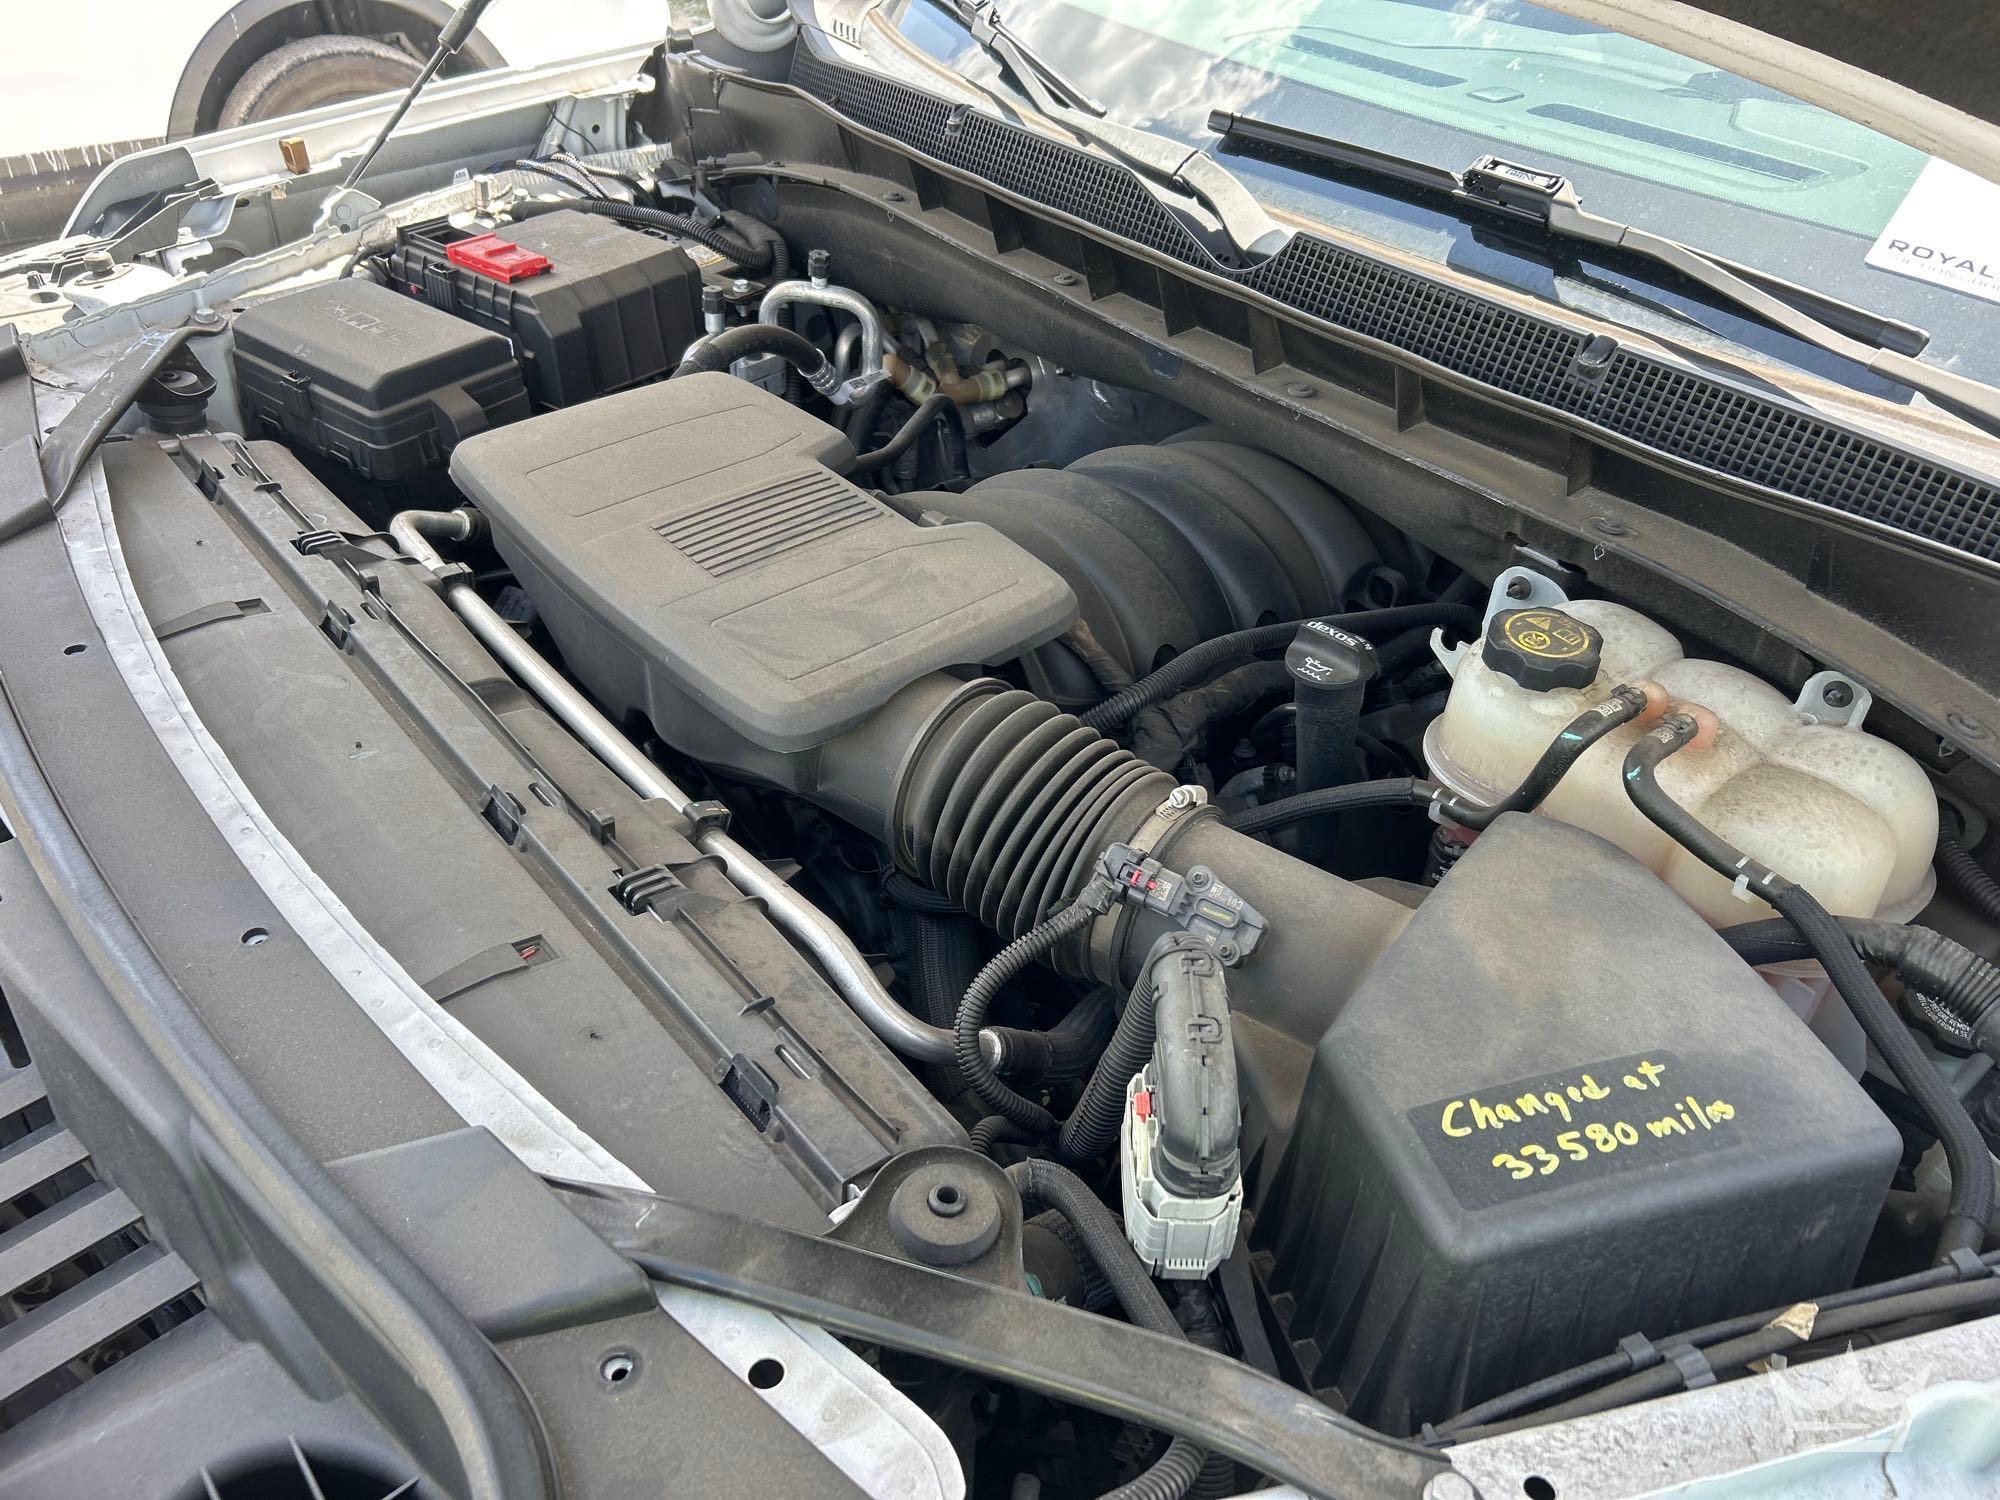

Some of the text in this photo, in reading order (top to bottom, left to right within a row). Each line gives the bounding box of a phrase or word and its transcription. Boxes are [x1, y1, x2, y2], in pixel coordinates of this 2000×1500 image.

[1887, 239, 1994, 279] ROYAL
[1306, 621, 1359, 647] dexos
[1441, 1061, 1666, 1138] Changed at
[1492, 1096, 1735, 1180] 33580 miles
